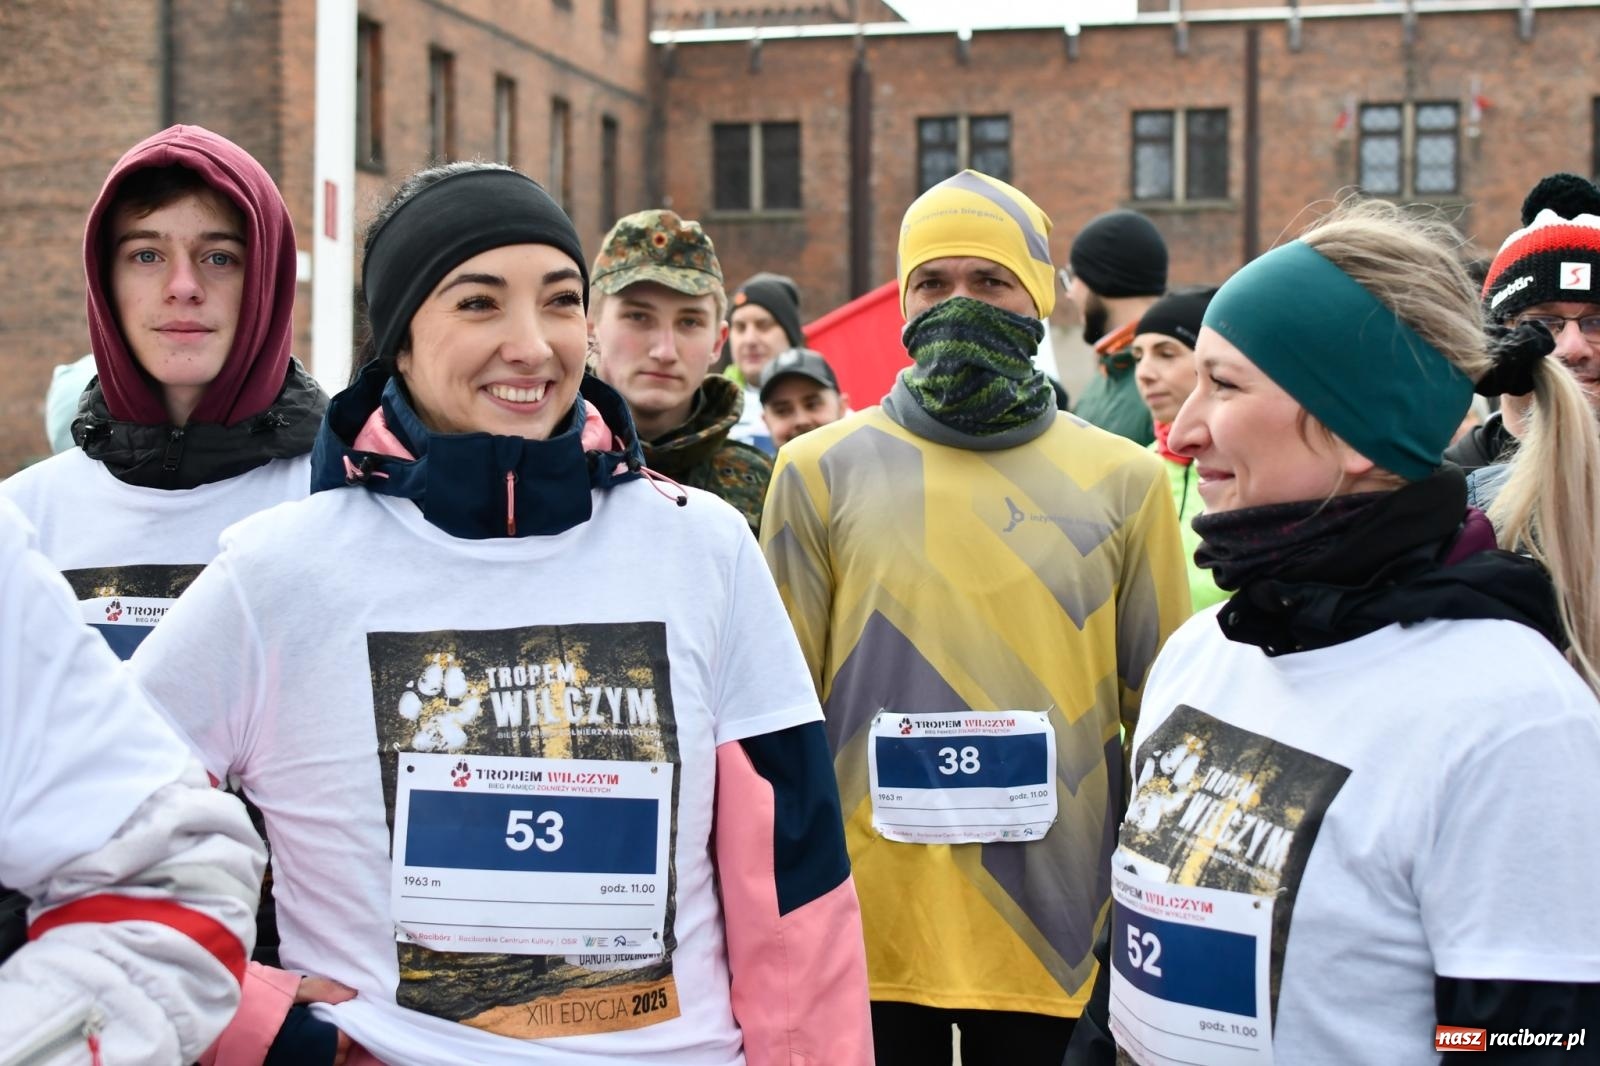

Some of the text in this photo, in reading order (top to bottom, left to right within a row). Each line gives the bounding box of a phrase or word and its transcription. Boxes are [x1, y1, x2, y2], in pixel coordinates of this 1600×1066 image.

[485, 662, 576, 688] TROPEM
[490, 686, 659, 728] WILCZYM
[916, 719, 1016, 729] TROPEM WILCZYM
[938, 745, 981, 775] 38
[476, 768, 620, 785] TROPEM WILCZYM
[488, 782, 505, 790] BIEG
[878, 793, 895, 802] 1963
[1009, 790, 1048, 802] godz. 11.00
[505, 810, 564, 852] 53
[1178, 791, 1295, 872] WILCZYM
[403, 875, 441, 887] 1963 m
[600, 883, 656, 895] godz. 11.00
[1145, 891, 1213, 913] WILCZYM
[1127, 923, 1162, 978] 52
[526, 987, 668, 1026] XIII EDYCJA 2025
[1199, 1018, 1258, 1038] godz. 11.00
